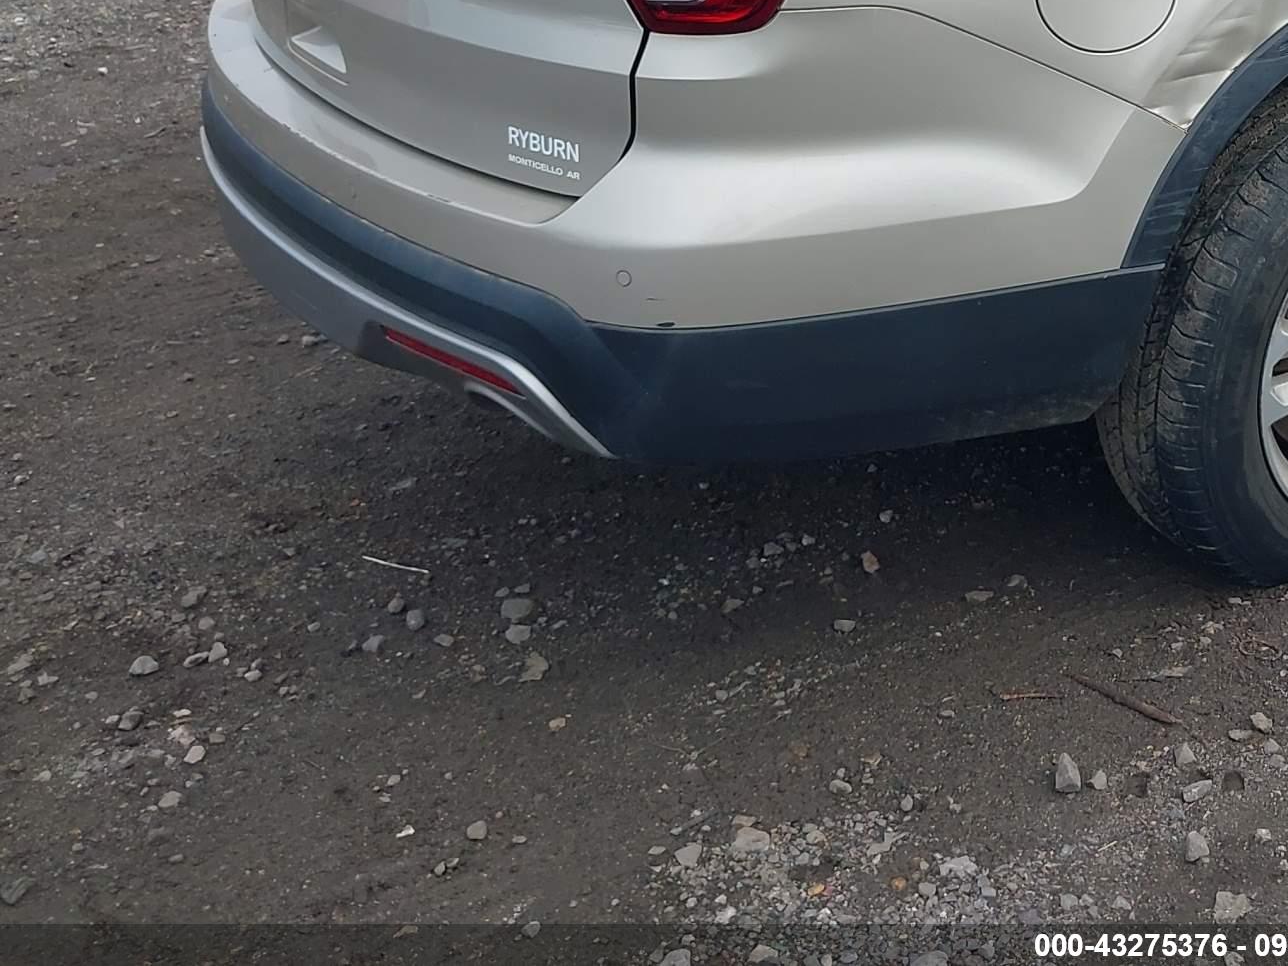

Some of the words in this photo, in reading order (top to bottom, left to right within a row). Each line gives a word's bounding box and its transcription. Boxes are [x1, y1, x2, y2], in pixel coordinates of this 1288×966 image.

[507, 126, 580, 163] RYBURN
[508, 153, 564, 176] MONTICELLO
[566, 170, 580, 180] AR
